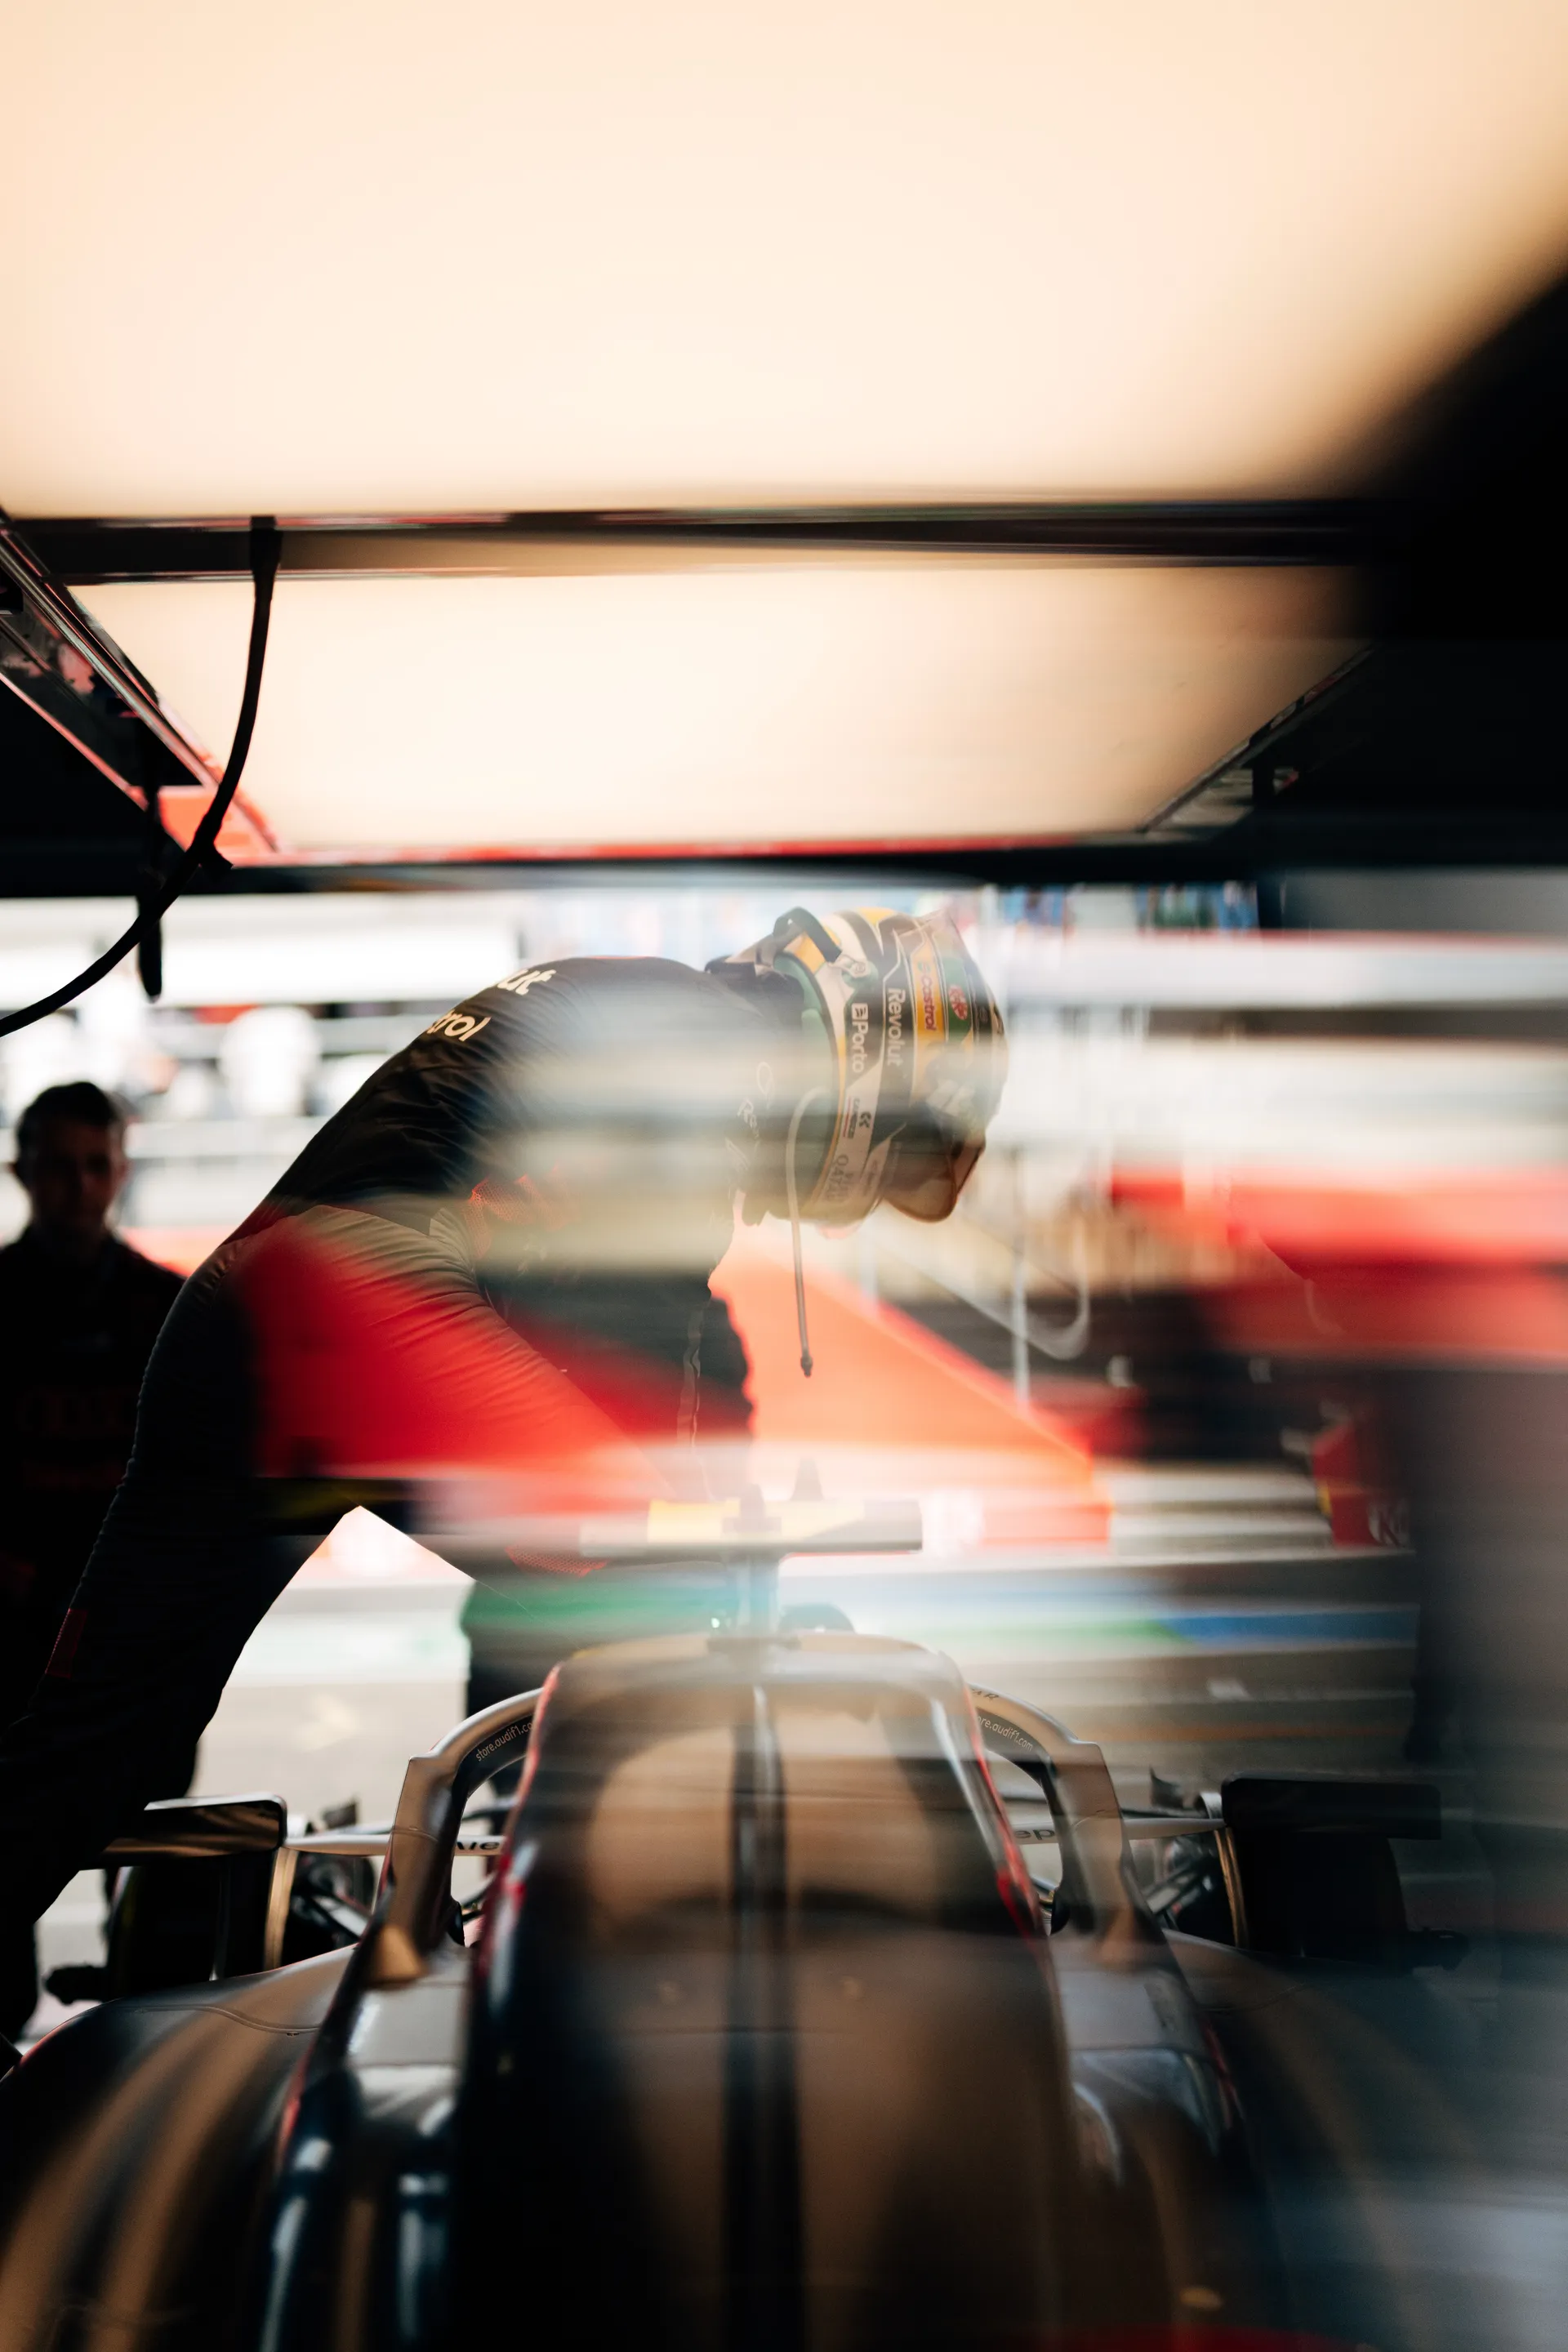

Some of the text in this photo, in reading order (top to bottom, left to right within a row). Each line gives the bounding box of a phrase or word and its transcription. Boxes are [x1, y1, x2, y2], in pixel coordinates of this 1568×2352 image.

[887, 988, 906, 1067] Revolut
[921, 975, 937, 1031] Castrol
[851, 1021, 869, 1073] Porto
